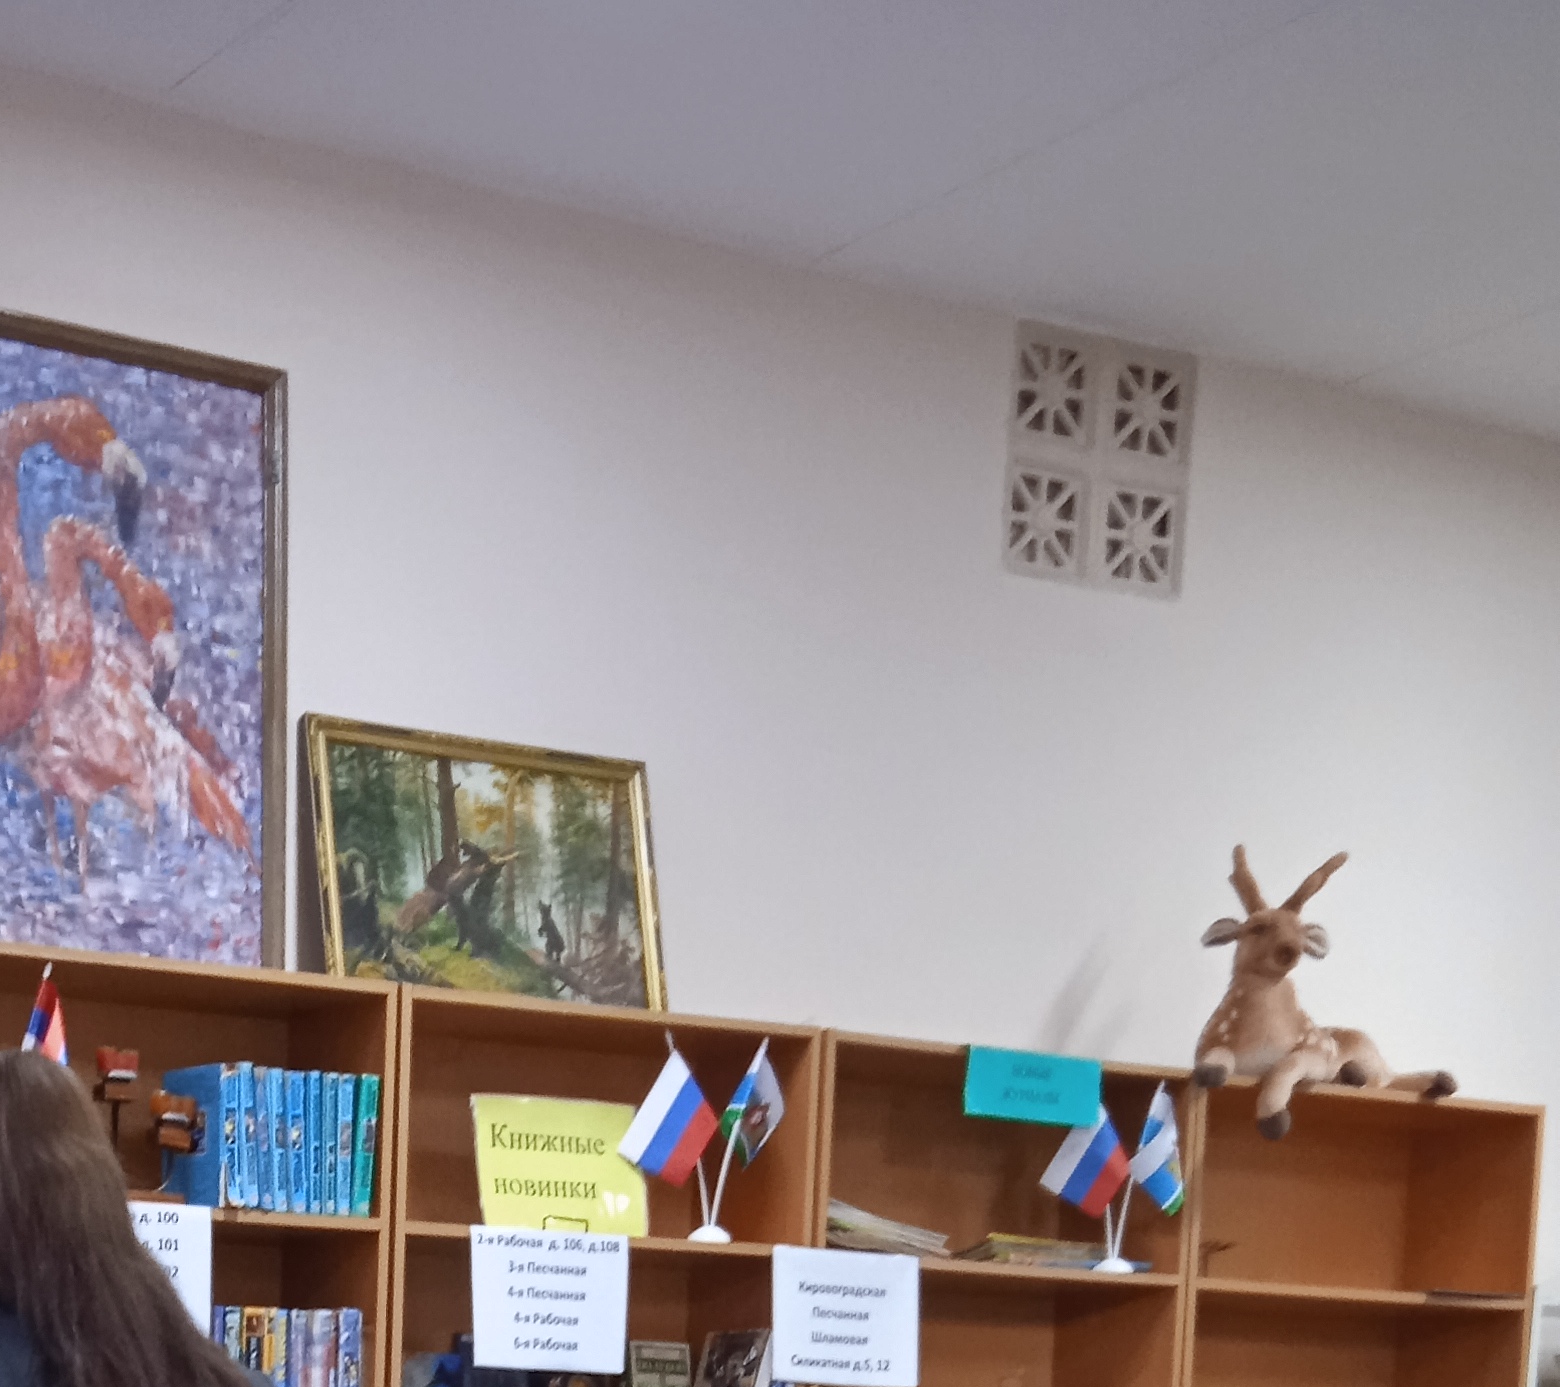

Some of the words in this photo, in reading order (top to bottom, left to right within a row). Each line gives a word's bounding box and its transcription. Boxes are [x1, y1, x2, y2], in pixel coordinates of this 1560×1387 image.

[491, 1122, 606, 1156] Книжные
[493, 1177, 597, 1200] новинки
[157, 1211, 179, 1224] 100
[158, 1238, 179, 1251] 101
[477, 1233, 495, 1245] 2-я
[497, 1234, 543, 1249] Рабочая
[527, 1261, 587, 1277] Песчанная
[507, 1286, 524, 1299] 4-я
[527, 1287, 586, 1301] Песчанная
[798, 1280, 887, 1298] Кировоградская
[513, 1311, 530, 1324] 4-я
[533, 1312, 579, 1326] Рабочая
[812, 1306, 870, 1321] Песчанная
[532, 1337, 578, 1351] Рабочая
[811, 1330, 868, 1345] Шламовая
[791, 1354, 851, 1369] Силикатная
